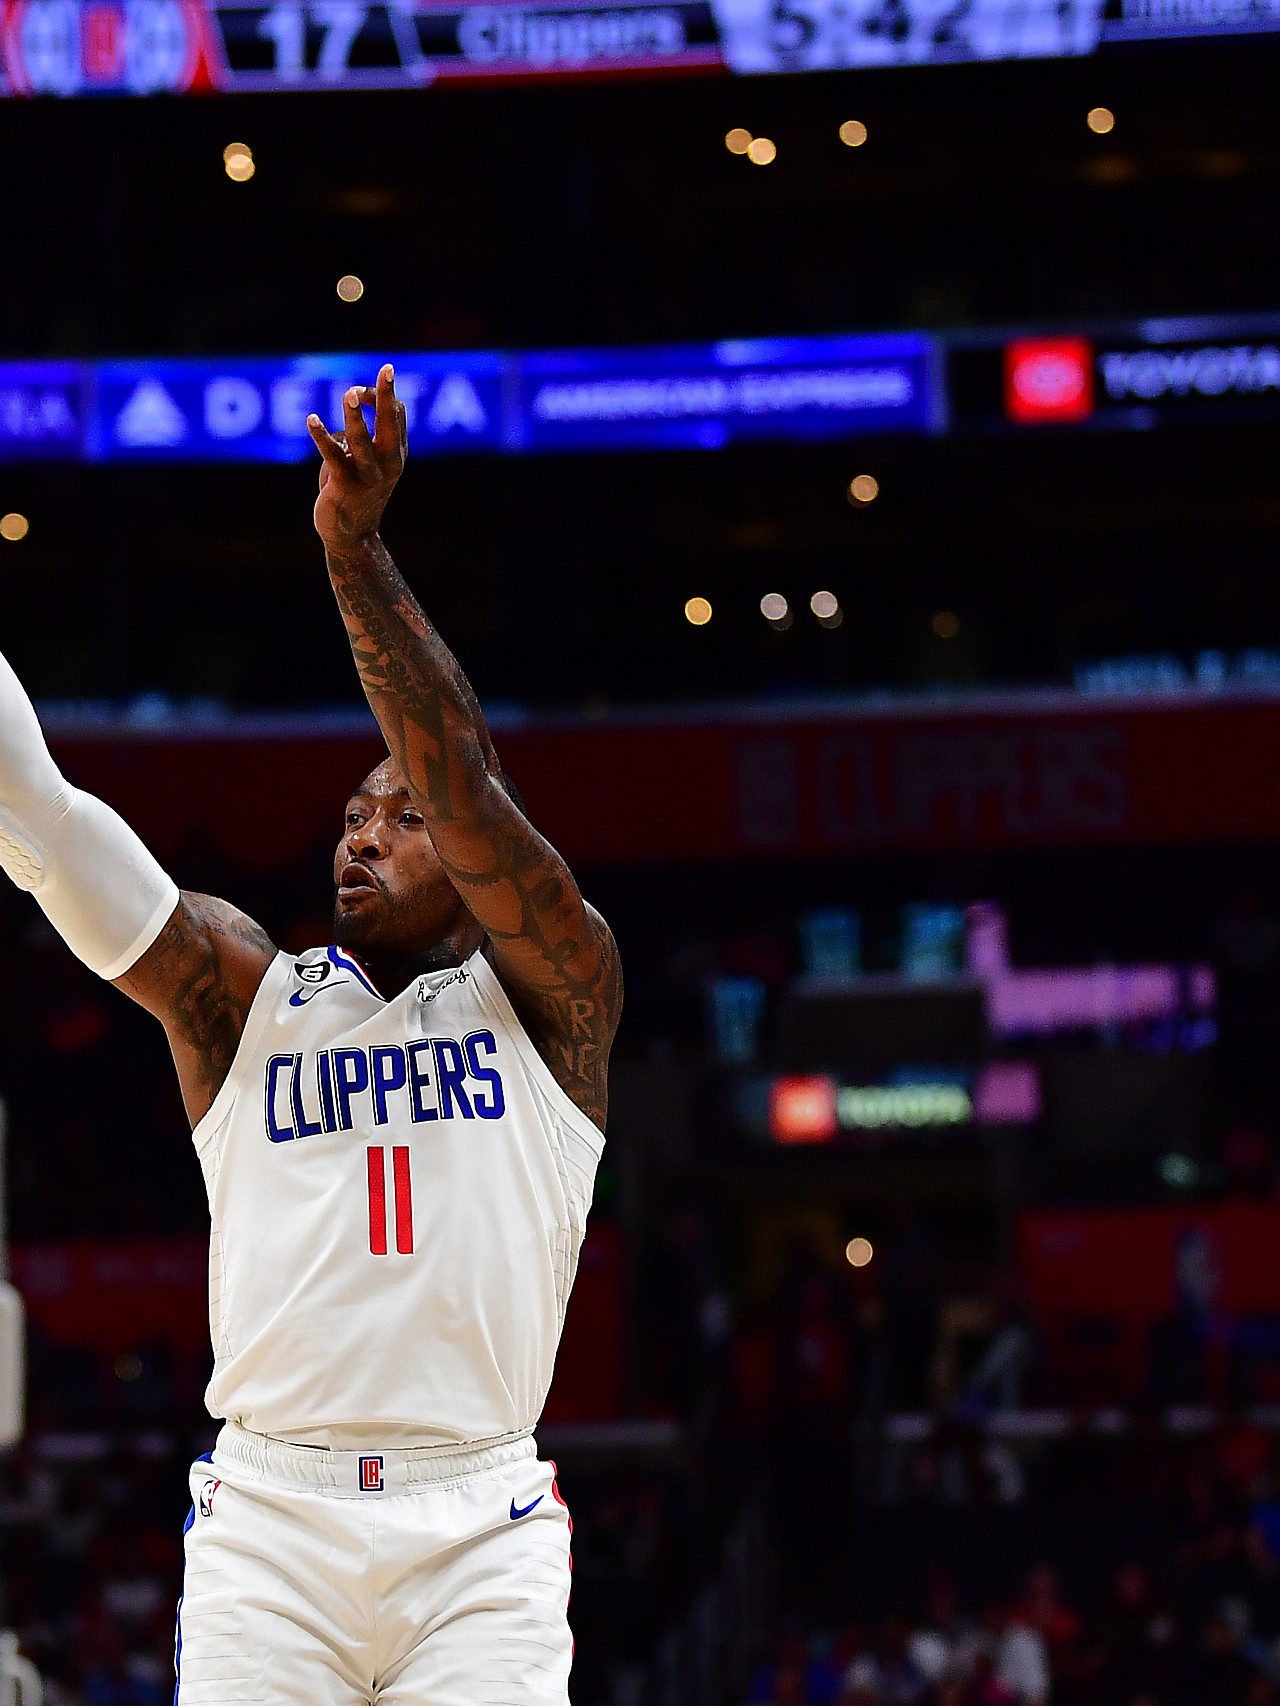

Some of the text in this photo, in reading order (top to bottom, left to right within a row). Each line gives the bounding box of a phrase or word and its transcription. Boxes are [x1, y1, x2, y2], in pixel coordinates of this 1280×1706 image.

[261, 1, 366, 82] 17
[457, 5, 683, 67] Clippers
[265, 1027, 507, 1144] CLIPPERS
[366, 1144, 414, 1256] 11
